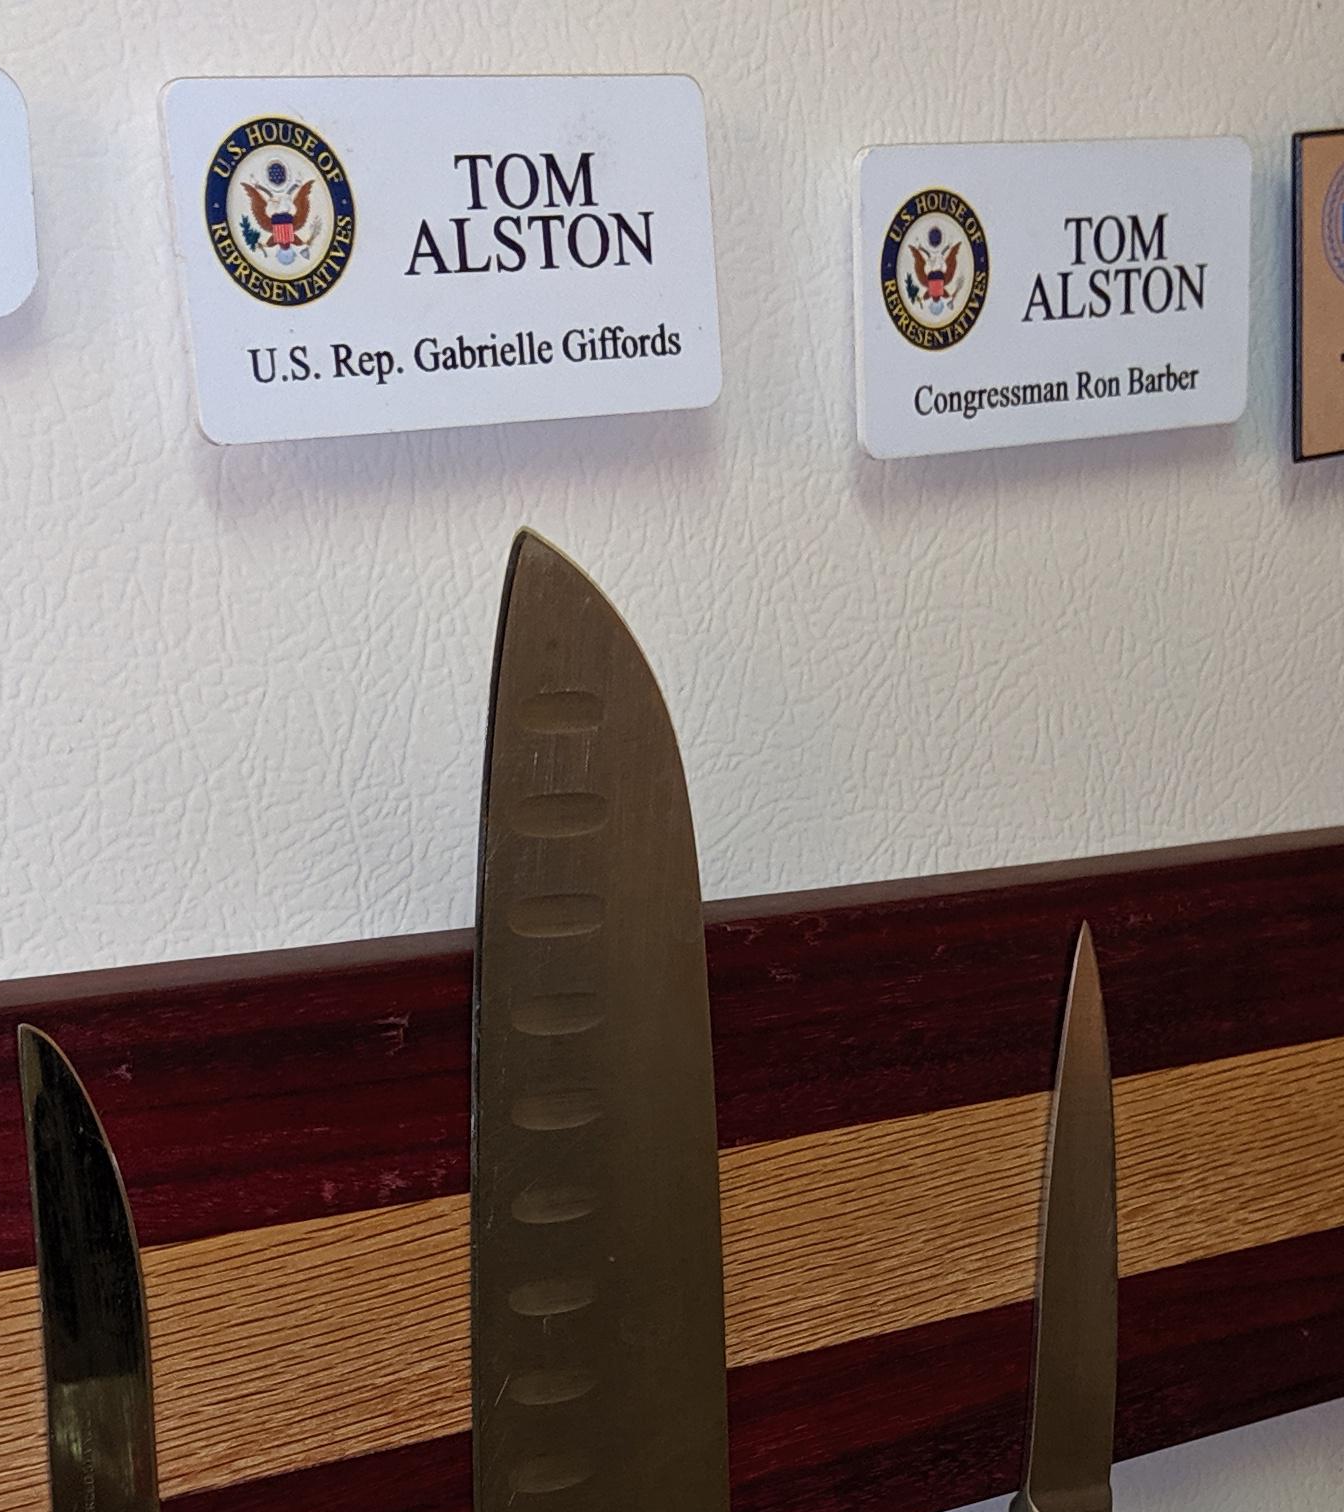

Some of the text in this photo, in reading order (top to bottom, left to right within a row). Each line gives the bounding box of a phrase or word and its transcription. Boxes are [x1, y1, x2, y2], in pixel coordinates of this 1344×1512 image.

[213, 121, 345, 184] U.S. HOUSE OF
[453, 152, 599, 211] TOM
[404, 211, 655, 276] ALSTON
[888, 192, 985, 245] U.S. HOUSE OF
[1064, 214, 1169, 266] TOM
[211, 215, 353, 303] REPRESENTATIVES
[883, 270, 987, 347] REPRESENTATIVES
[1022, 263, 1208, 322] ALSTON
[246, 322, 682, 385] U.S. Rep. Gabrielle Giffords
[914, 362, 1200, 420] Congressman Ron Barber
